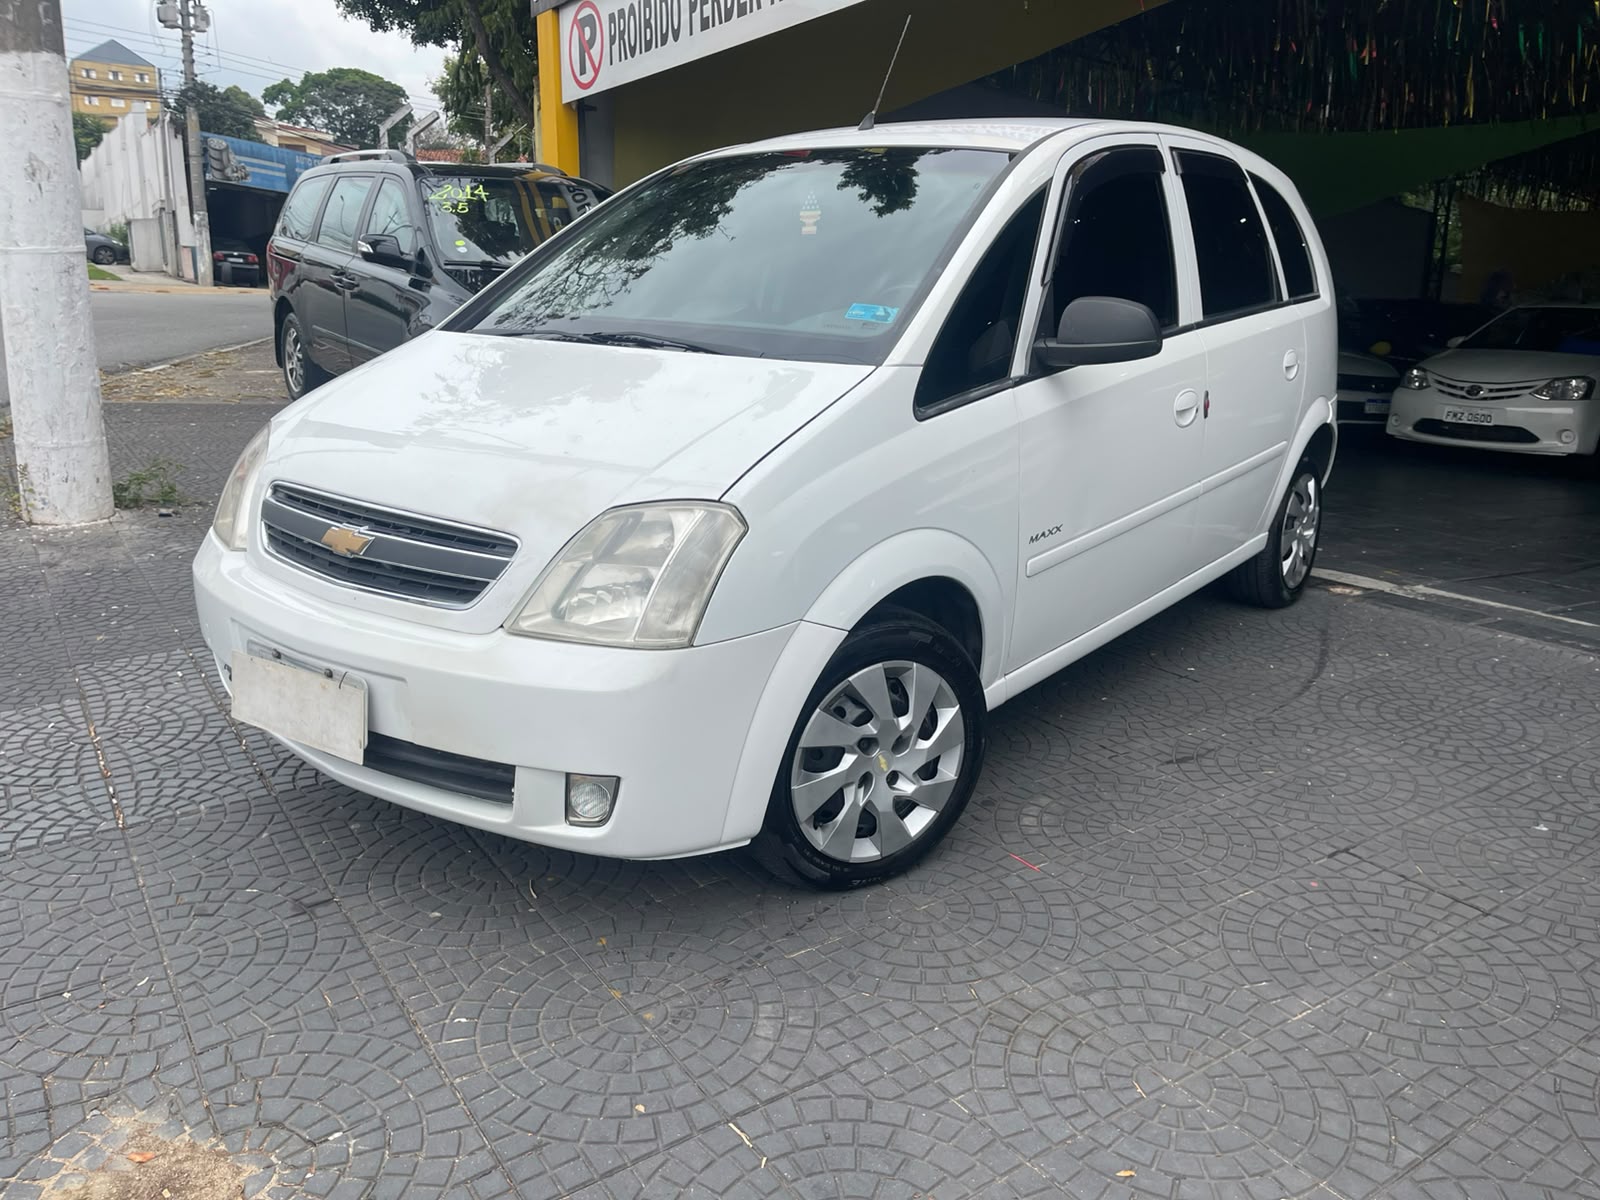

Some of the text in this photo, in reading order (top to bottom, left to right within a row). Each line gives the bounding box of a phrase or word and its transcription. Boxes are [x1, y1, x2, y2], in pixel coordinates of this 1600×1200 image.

[578, 13, 597, 76] P
[608, 0, 681, 66] PROIBIDO
[429, 185, 489, 202] 2014
[1028, 523, 1063, 544] MAXX
